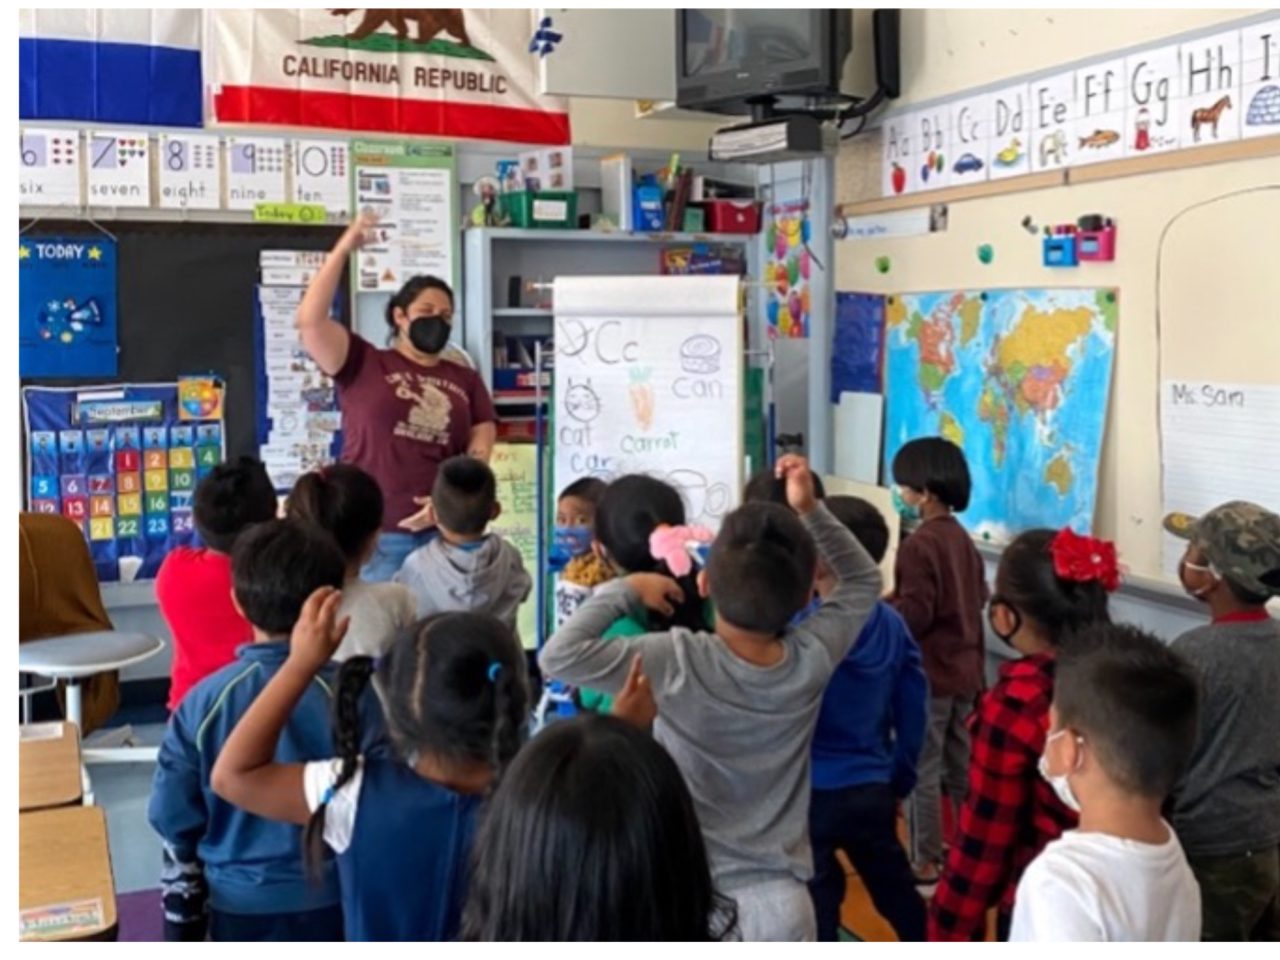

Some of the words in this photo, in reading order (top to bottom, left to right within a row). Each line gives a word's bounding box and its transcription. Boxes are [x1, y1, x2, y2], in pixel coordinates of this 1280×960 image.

[282, 55, 400, 84] CALIFORNIA
[413, 66, 508, 94] REPUBLIC
[921, 115, 943, 152] Bb
[957, 106, 979, 144] Cc
[995, 93, 1023, 137] Dd
[1038, 87, 1068, 129] Ee
[1084, 69, 1115, 117] Ff
[1131, 61, 1169, 127] Gg
[1189, 44, 1232, 97] Hh
[19, 134, 38, 167] 6
[92, 136, 116, 168] 7
[168, 140, 184, 172] 8
[242, 143, 256, 174] 9
[295, 141, 329, 177] 10
[19, 181, 43, 194] six
[91, 184, 140, 196] seven
[162, 181, 206, 206] eight
[230, 187, 266, 200] nine
[297, 185, 322, 201] ten
[35, 244, 84, 259] TODAY
[150, 453, 161, 467] 2
[174, 451, 183, 464] 3
[203, 450, 214, 463] 4
[38, 480, 49, 495] 5
[67, 479, 78, 494] 6
[123, 476, 134, 490] 8
[152, 474, 162, 488] 9
[174, 472, 191, 487] 10
[68, 501, 84, 515] 13
[94, 499, 111, 513] 14
[123, 498, 138, 512] 15
[150, 497, 166, 511] 16
[175, 495, 190, 508] 17
[118, 520, 137, 534] 22
[148, 518, 167, 533] 23
[173, 516, 193, 531] 24
